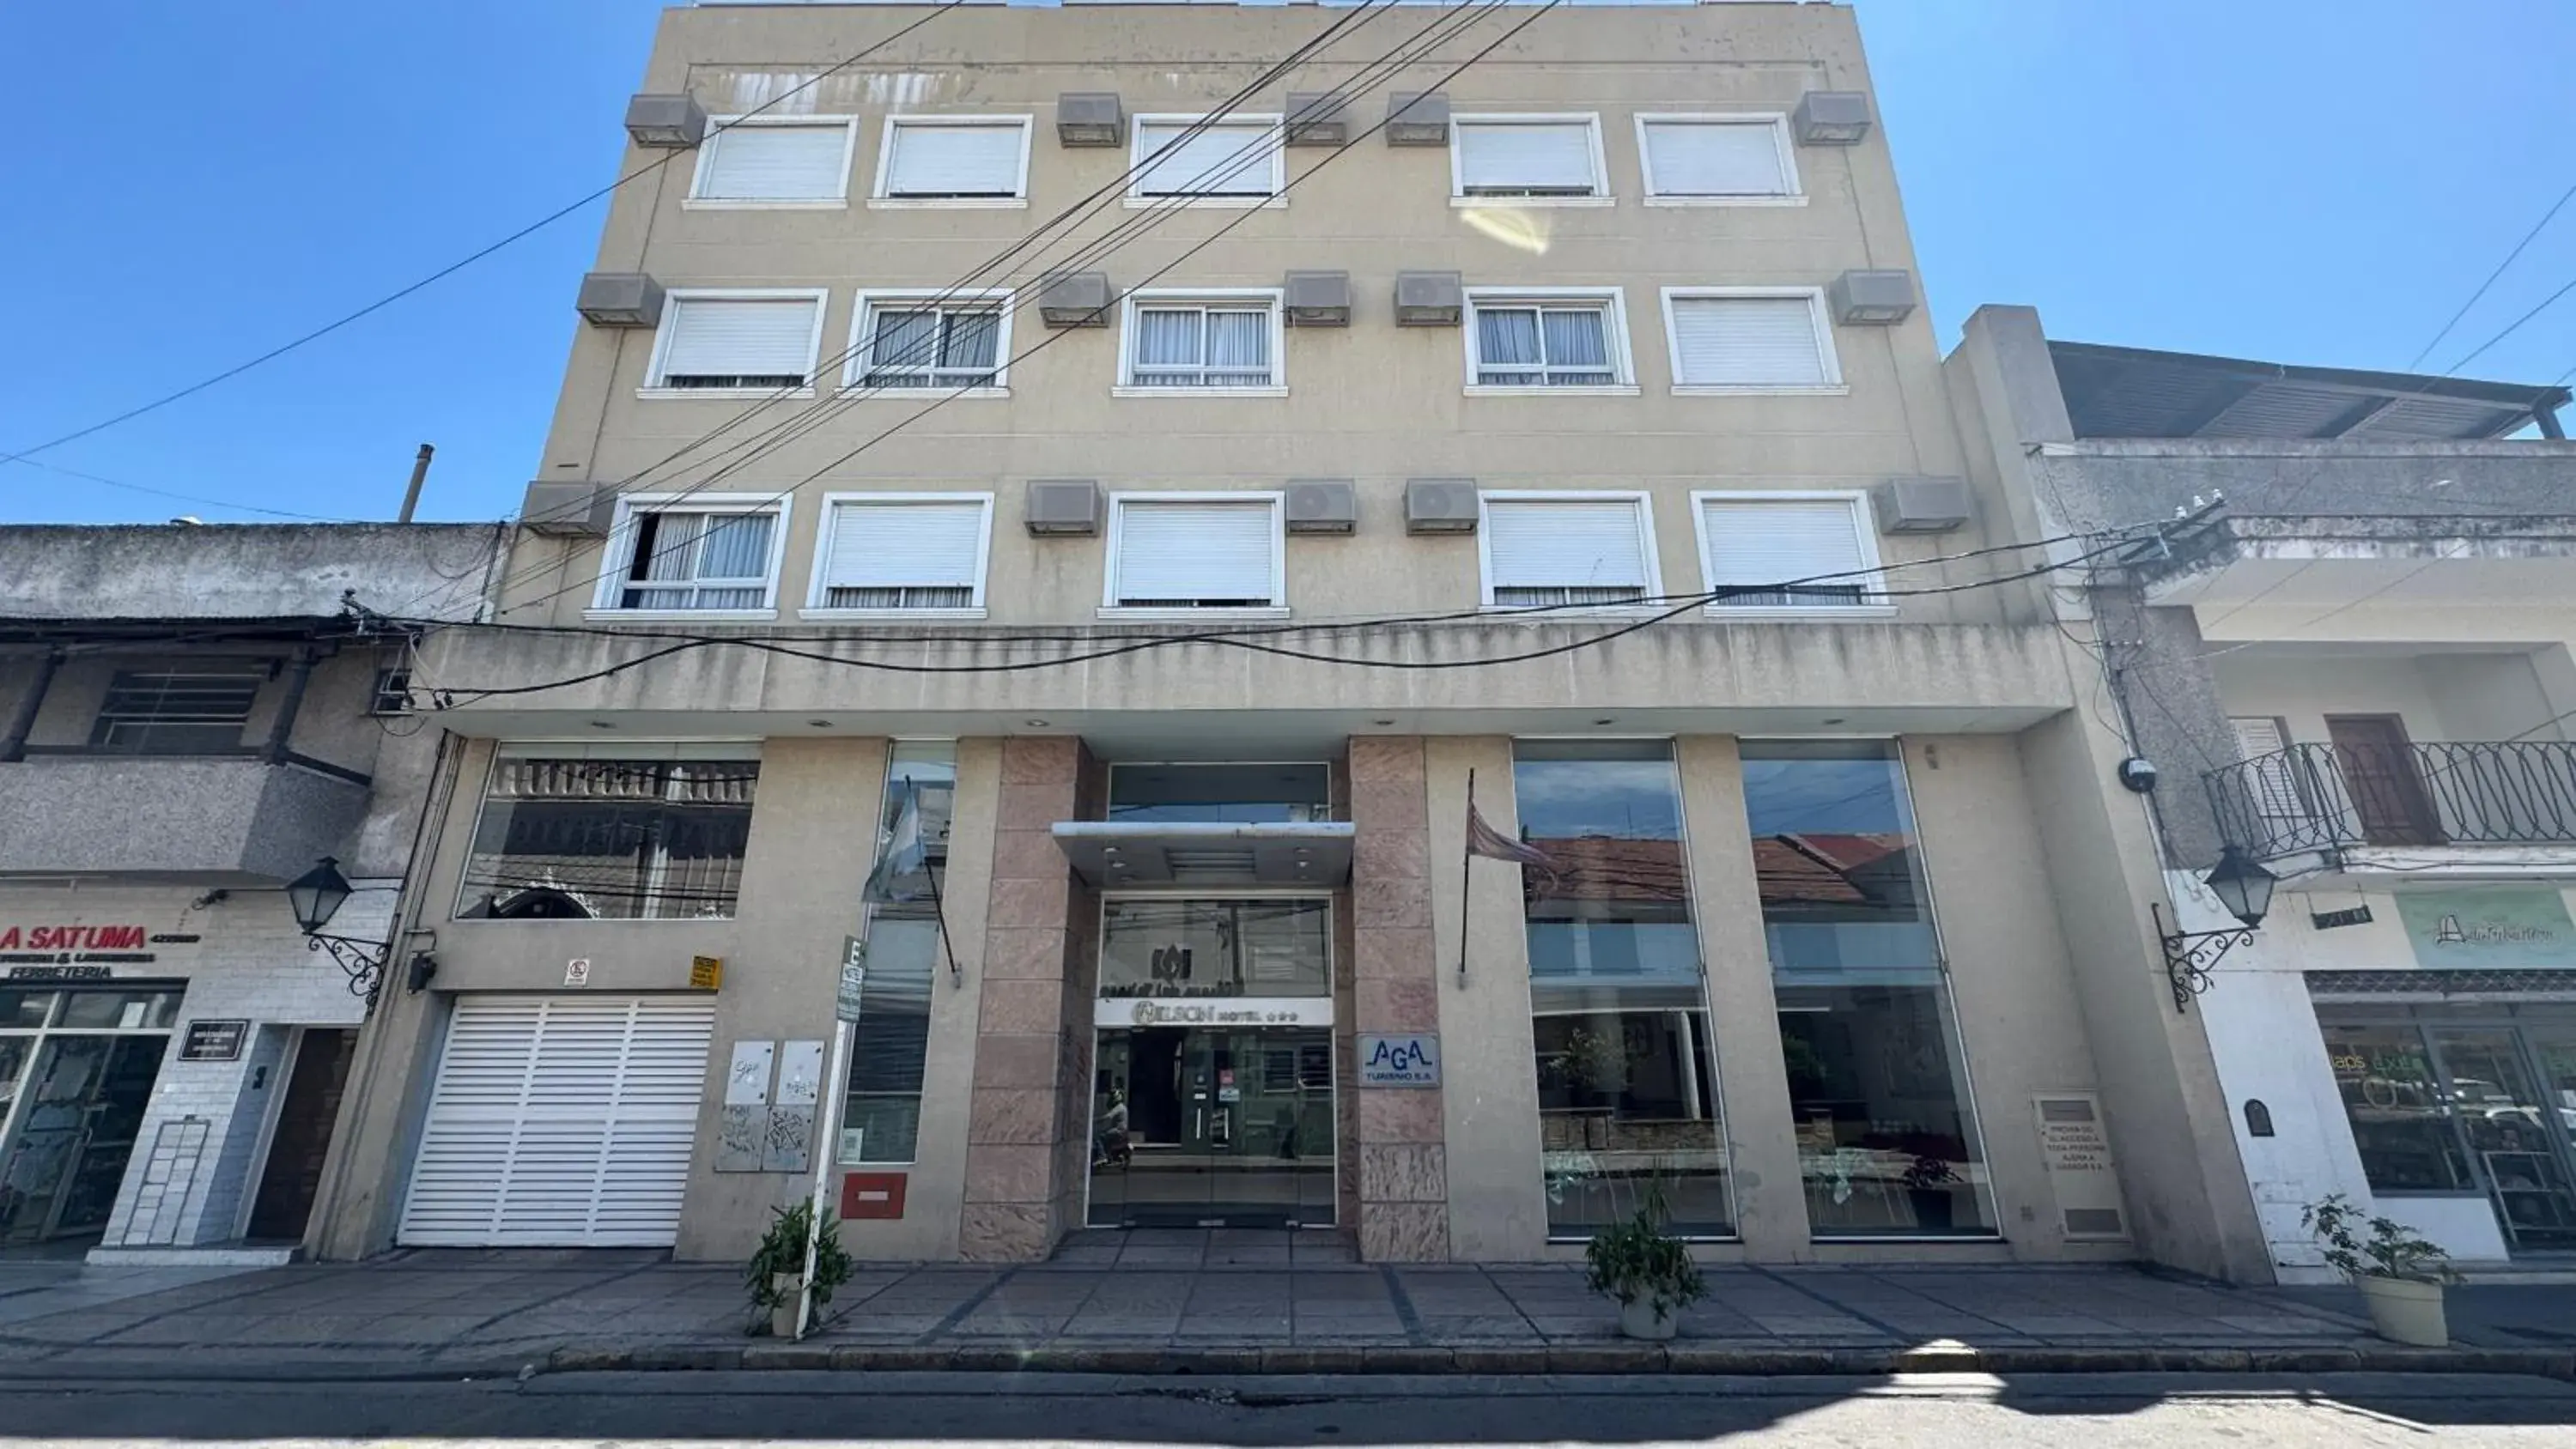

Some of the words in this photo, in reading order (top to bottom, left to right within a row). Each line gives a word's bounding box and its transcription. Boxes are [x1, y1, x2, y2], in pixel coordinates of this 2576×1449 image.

[9, 967, 112, 979] FERRETERIA
[1365, 1040, 1433, 1070] AGA
[1367, 1072, 1413, 1081] TURISMO
